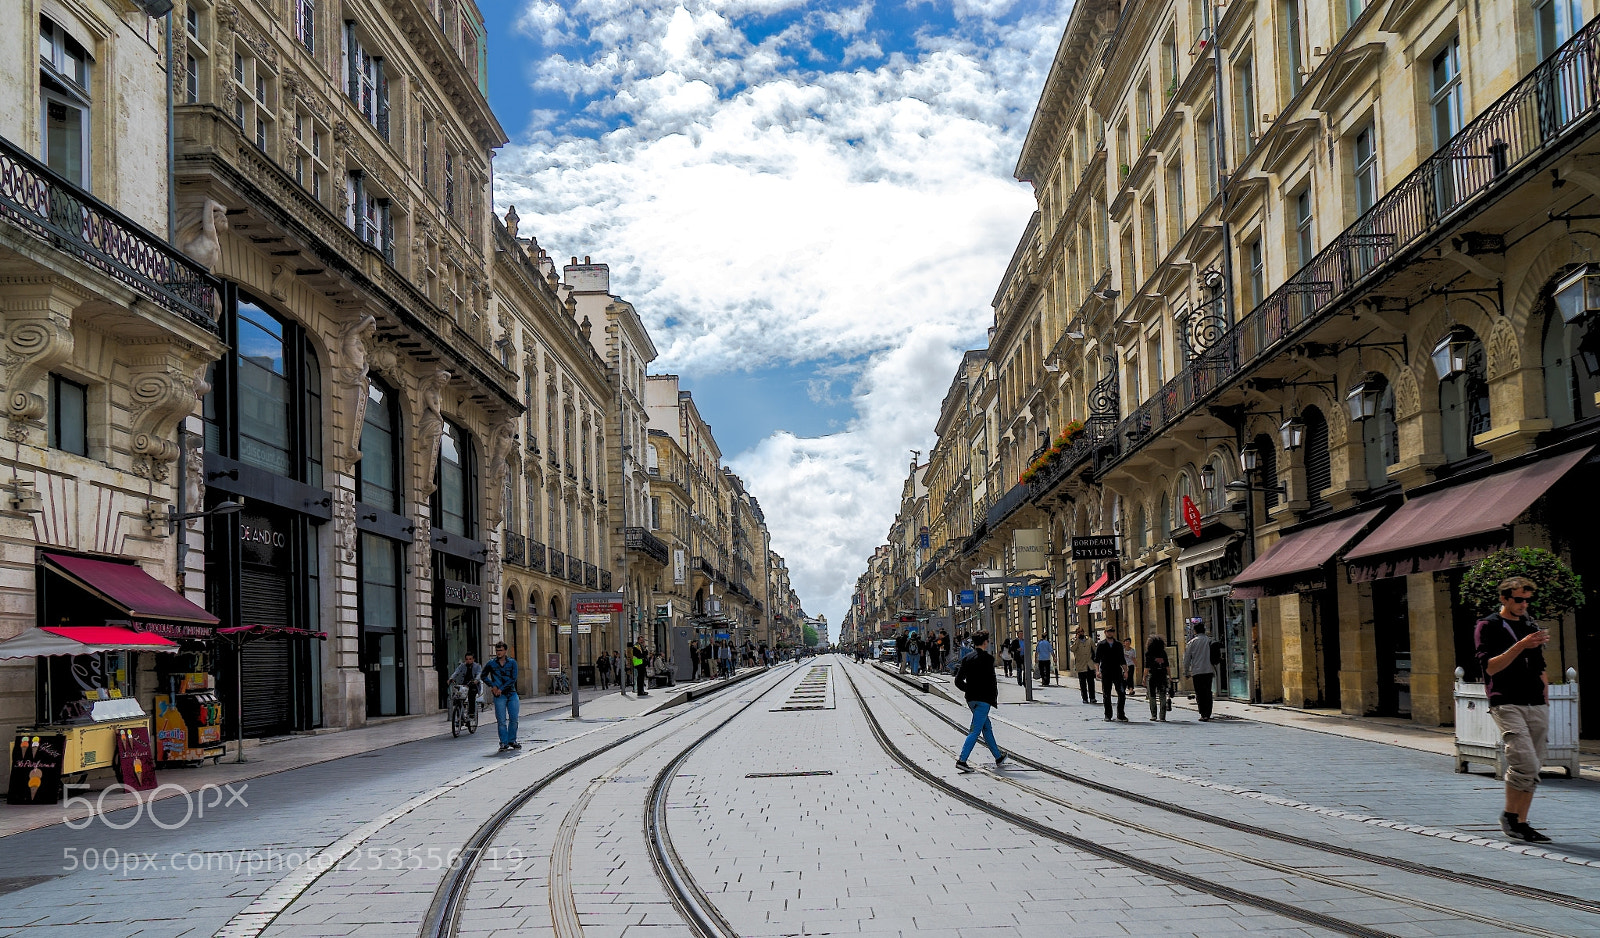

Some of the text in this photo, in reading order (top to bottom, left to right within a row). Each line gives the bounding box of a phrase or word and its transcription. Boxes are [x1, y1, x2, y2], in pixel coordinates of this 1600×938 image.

[1186, 501, 1200, 531] TABAC
[252, 527, 271, 545] AND
[272, 531, 285, 548] CO
[1073, 538, 1114, 547] BORDEAUX
[1075, 548, 1113, 557] STYLOS
[158, 727, 185, 740] Granita
